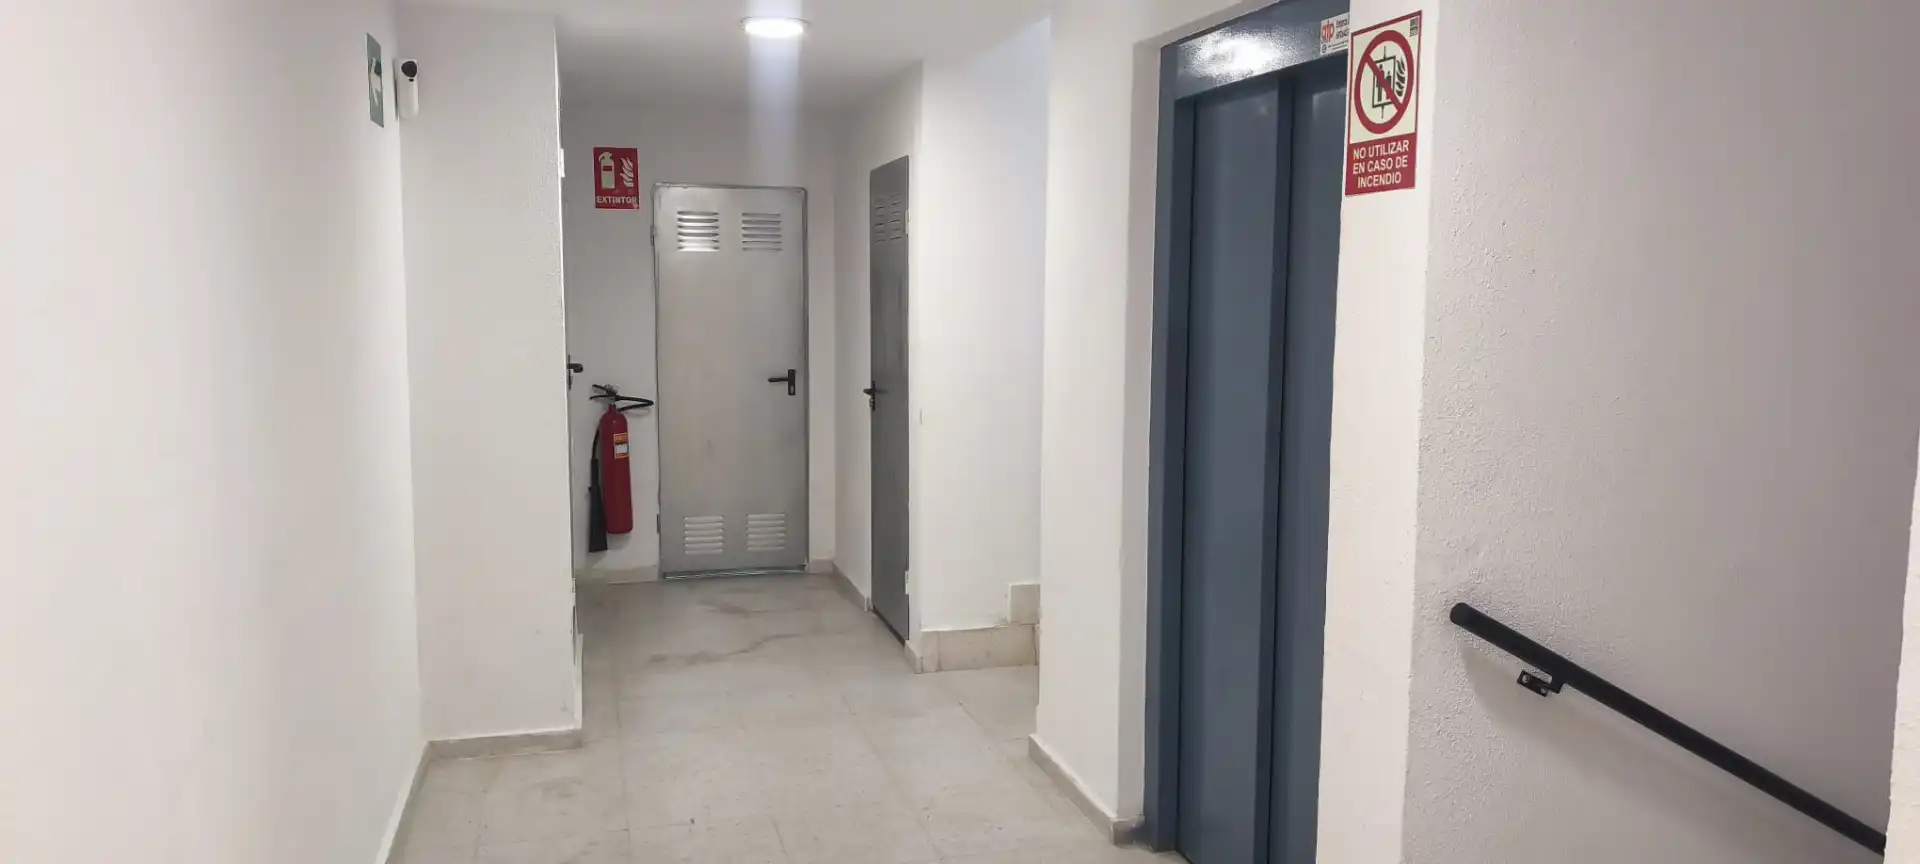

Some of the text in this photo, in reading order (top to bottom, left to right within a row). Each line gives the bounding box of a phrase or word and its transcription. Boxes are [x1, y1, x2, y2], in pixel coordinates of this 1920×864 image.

[1353, 139, 1410, 160] NO UTILIZAR
[1352, 155, 1408, 175] EN CASO DE
[1357, 171, 1402, 189] INCENDIO
[596, 195, 637, 204] EXTINTOR
